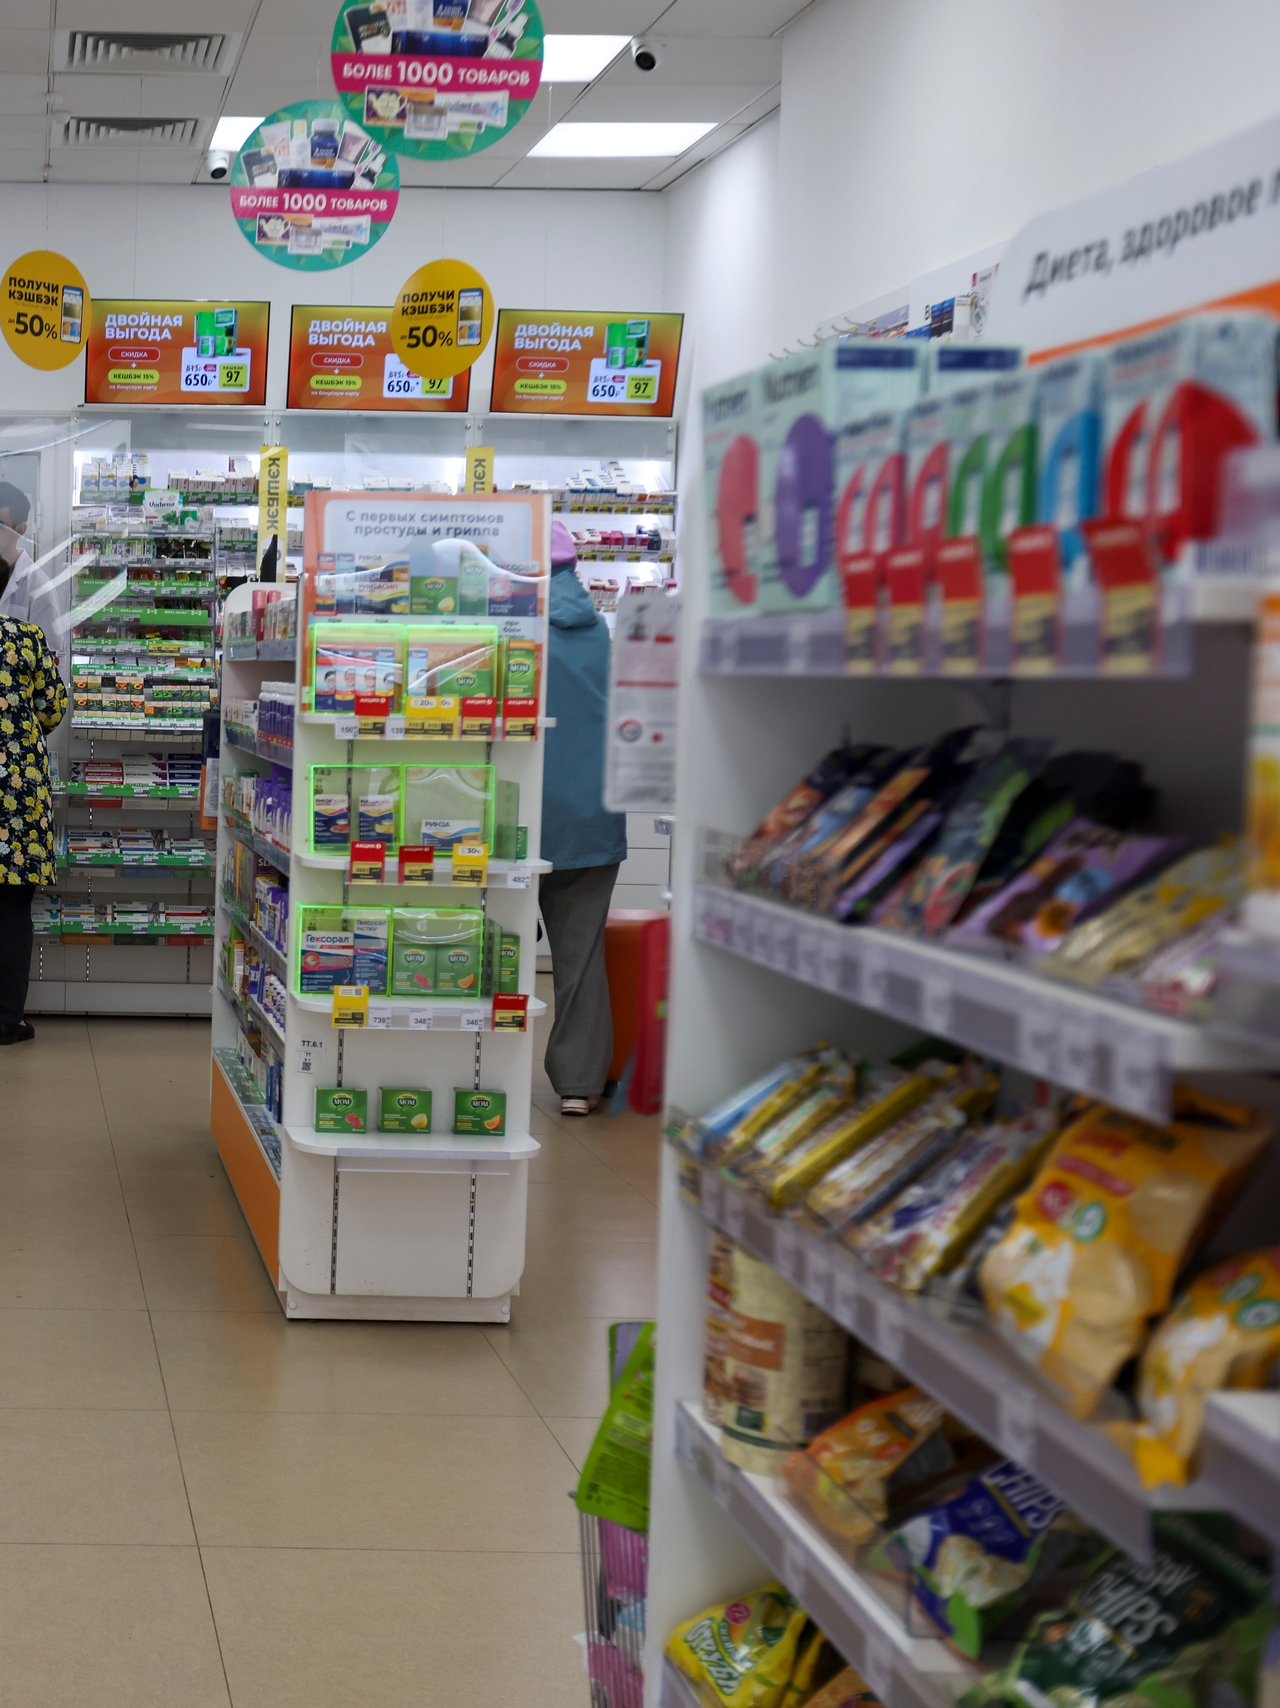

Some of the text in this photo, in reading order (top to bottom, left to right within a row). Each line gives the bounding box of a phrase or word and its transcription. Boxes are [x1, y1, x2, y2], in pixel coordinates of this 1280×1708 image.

[342, 61, 531, 87] БОЛЕЕ 1000 ТОВАРОВ
[239, 193, 388, 212] БОЛЕЕ 1000 ТОВАРОВ
[1023, 243, 1116, 300] Диета,
[1118, 184, 1263, 266] здоровое
[8, 276, 59, 294] ПОЛУЧИ
[8, 289, 59, 307] КЭШБЭК
[402, 290, 455, 304] ПОЛУЧИ
[401, 303, 454, 317] КЭШБЭК
[14, 311, 58, 340] 50%
[104, 311, 183, 328] ДВОЙНАЯ
[308, 317, 387, 333] ДВОЙНАЯ
[105, 327, 173, 342] ВЫГОДА
[406, 325, 454, 348] 50%
[514, 322, 595, 338] ДВОЙНАЯ
[308, 333, 376, 348] ВЫГОДА
[514, 337, 583, 352] ВЫГОДА
[120, 350, 148, 358] СКИДКА
[323, 356, 351, 364] СКИДКА
[226, 370, 240, 383] 97
[428, 378, 444, 389] 97
[634, 382, 649, 394] 97
[267, 457, 280, 531] КЭШБЭК
[346, 510, 505, 524] С первых симптомов
[354, 524, 500, 538] простуды и гриппа
[509, 664, 531, 672] МОМ
[306, 934, 350, 945] Гексорал
[405, 954, 424, 962] МОМ
[449, 955, 468, 963] МОМ
[301, 1040, 323, 1048] ТТ.6.1
[332, 1098, 352, 1106] МОМ
[398, 1098, 418, 1106] МОМ
[471, 1100, 491, 1108] МОМ
